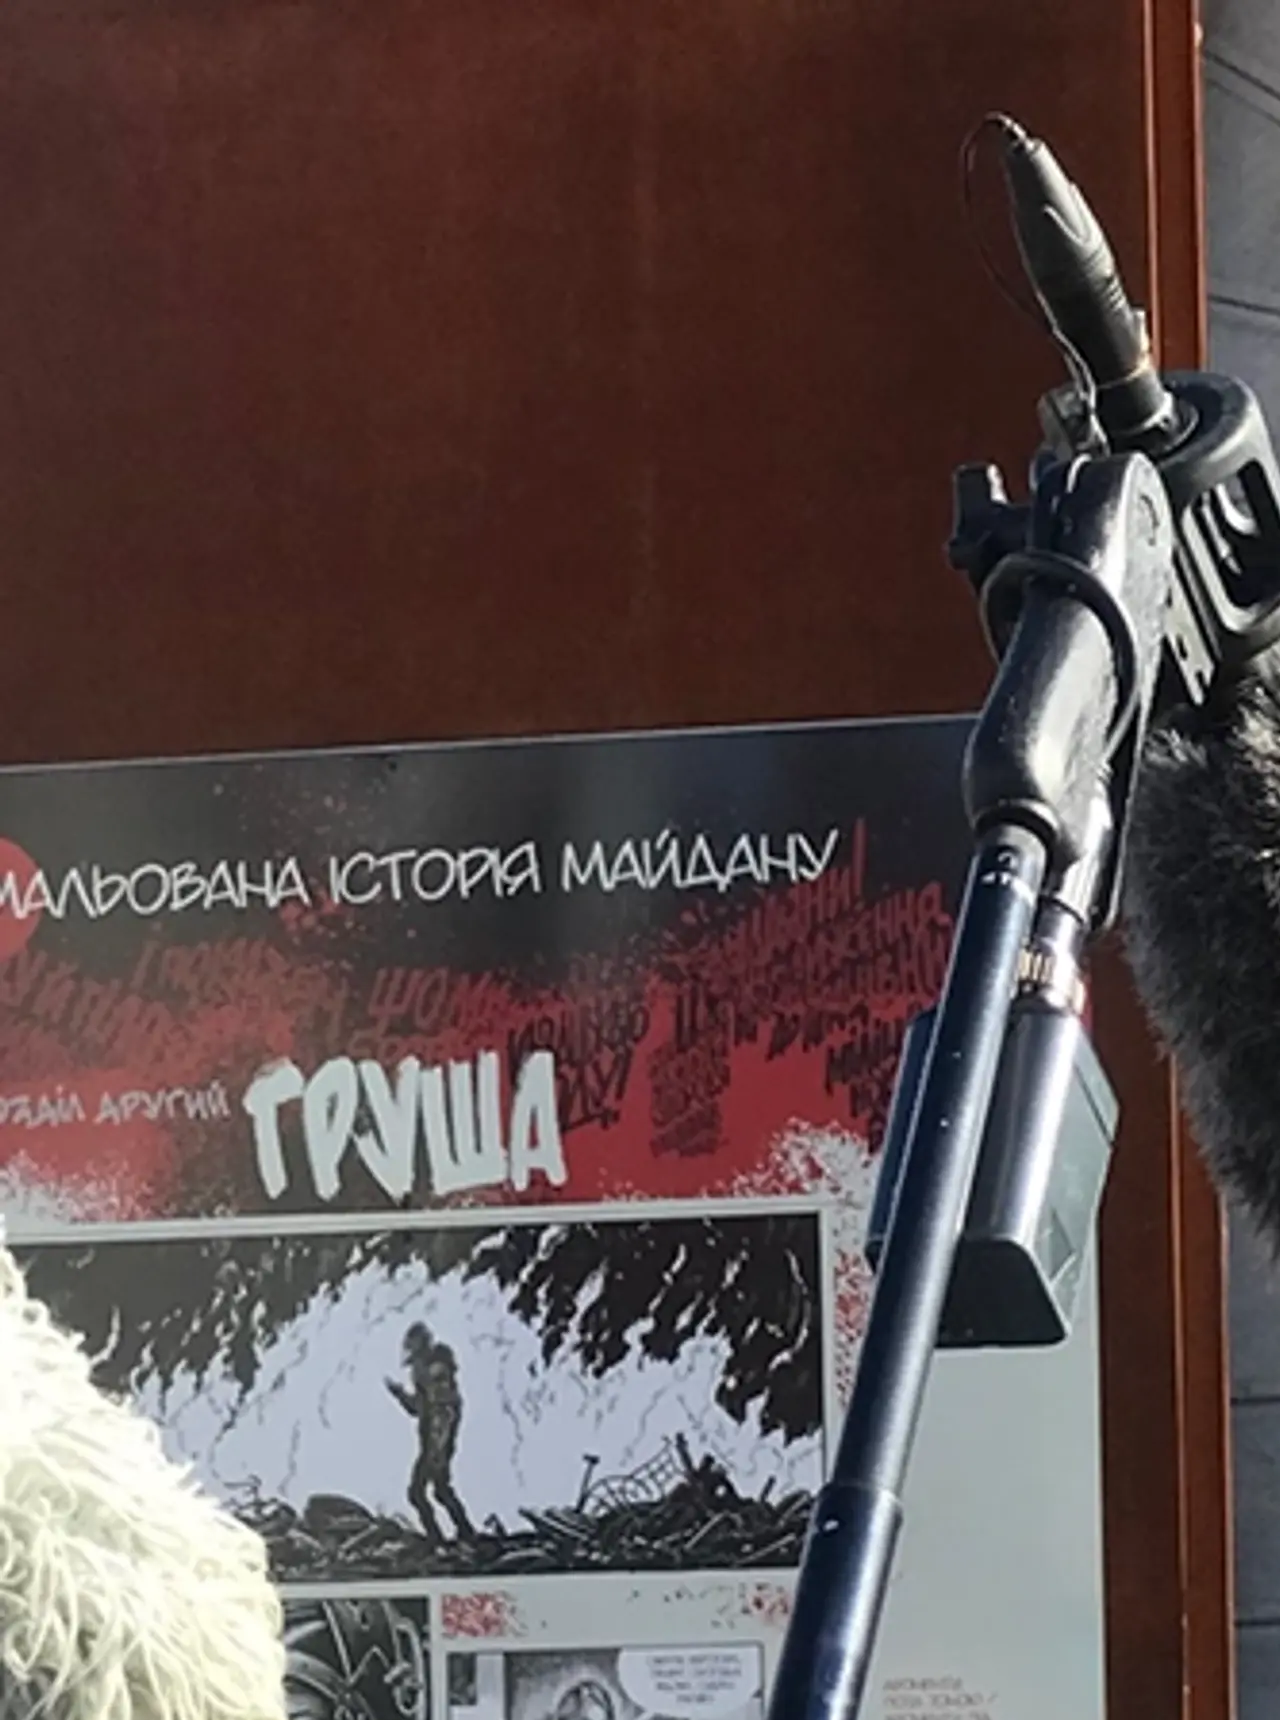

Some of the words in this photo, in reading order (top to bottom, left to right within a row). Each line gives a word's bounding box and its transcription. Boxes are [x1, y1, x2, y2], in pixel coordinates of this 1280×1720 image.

[329, 840, 541, 904] ІСТОРІЯ
[562, 828, 838, 893] МАЙДАНУ
[243, 1050, 568, 1204] ГРУША
